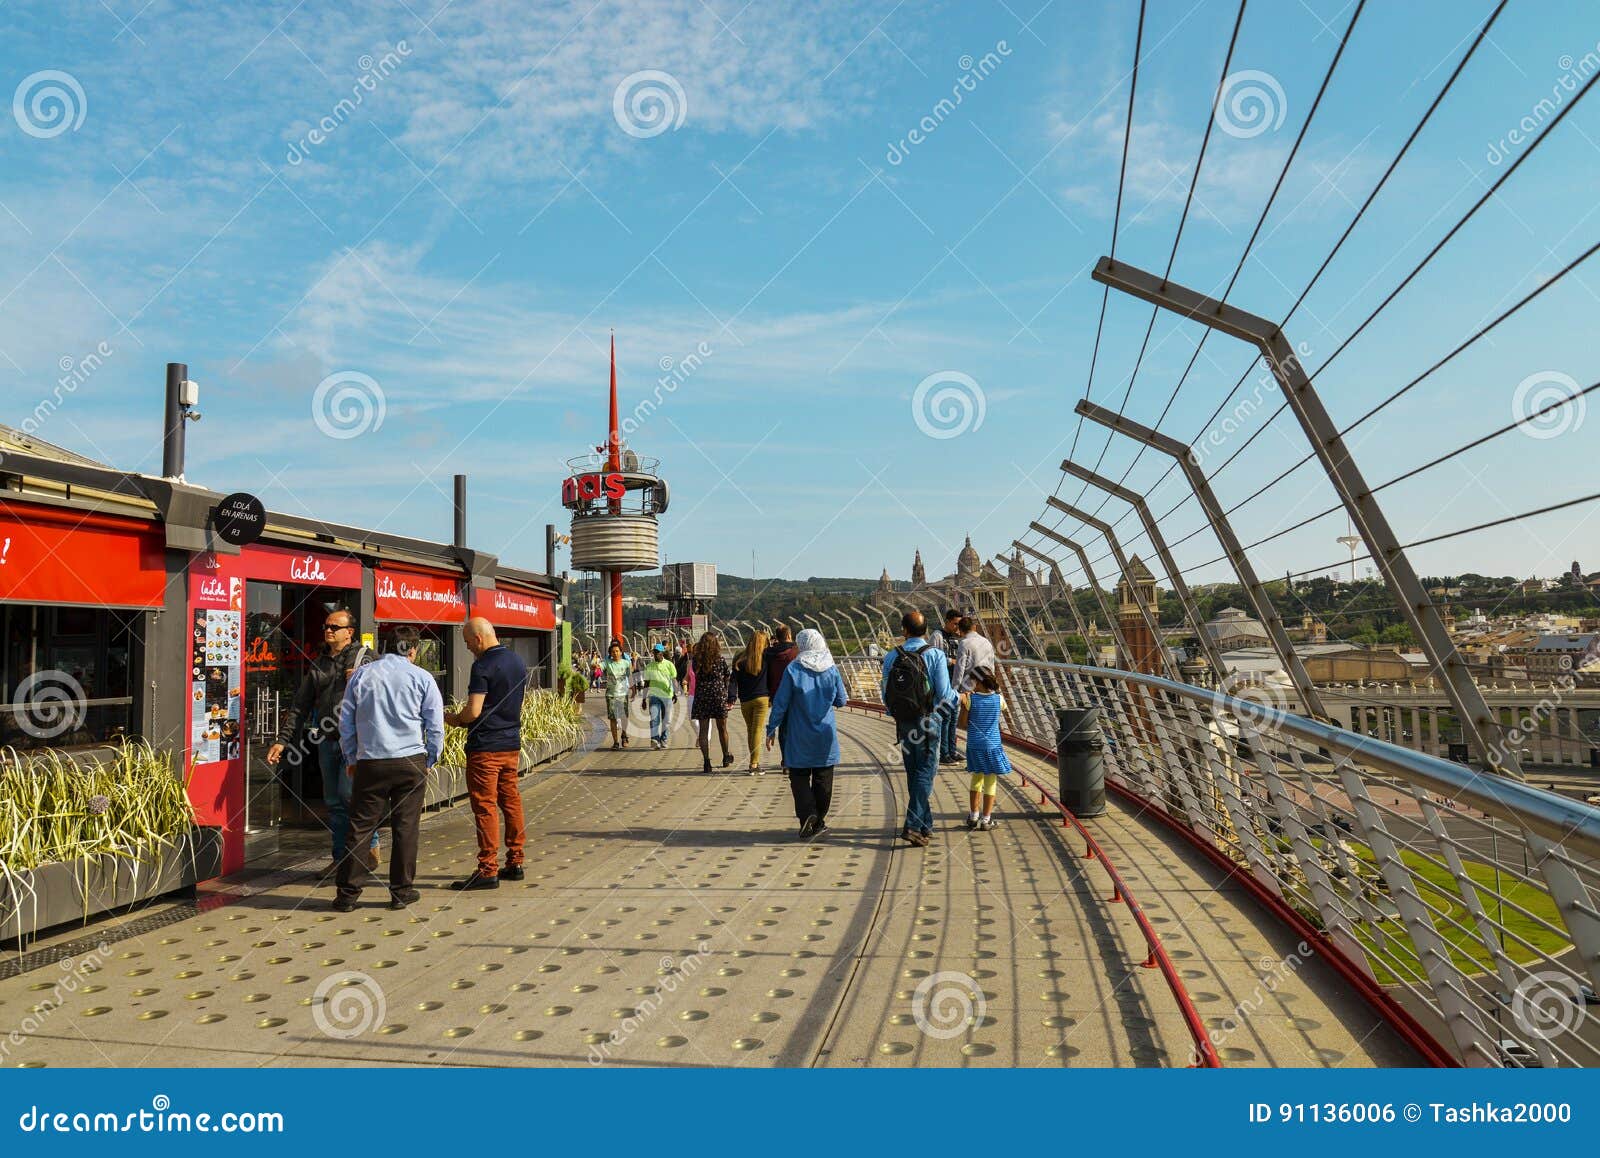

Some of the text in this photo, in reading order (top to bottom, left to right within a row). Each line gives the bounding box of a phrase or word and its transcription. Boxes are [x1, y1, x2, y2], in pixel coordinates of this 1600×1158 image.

[232, 501, 250, 510] LOLA
[221, 508, 258, 522] EN ARENAS
[231, 528, 240, 536] R3
